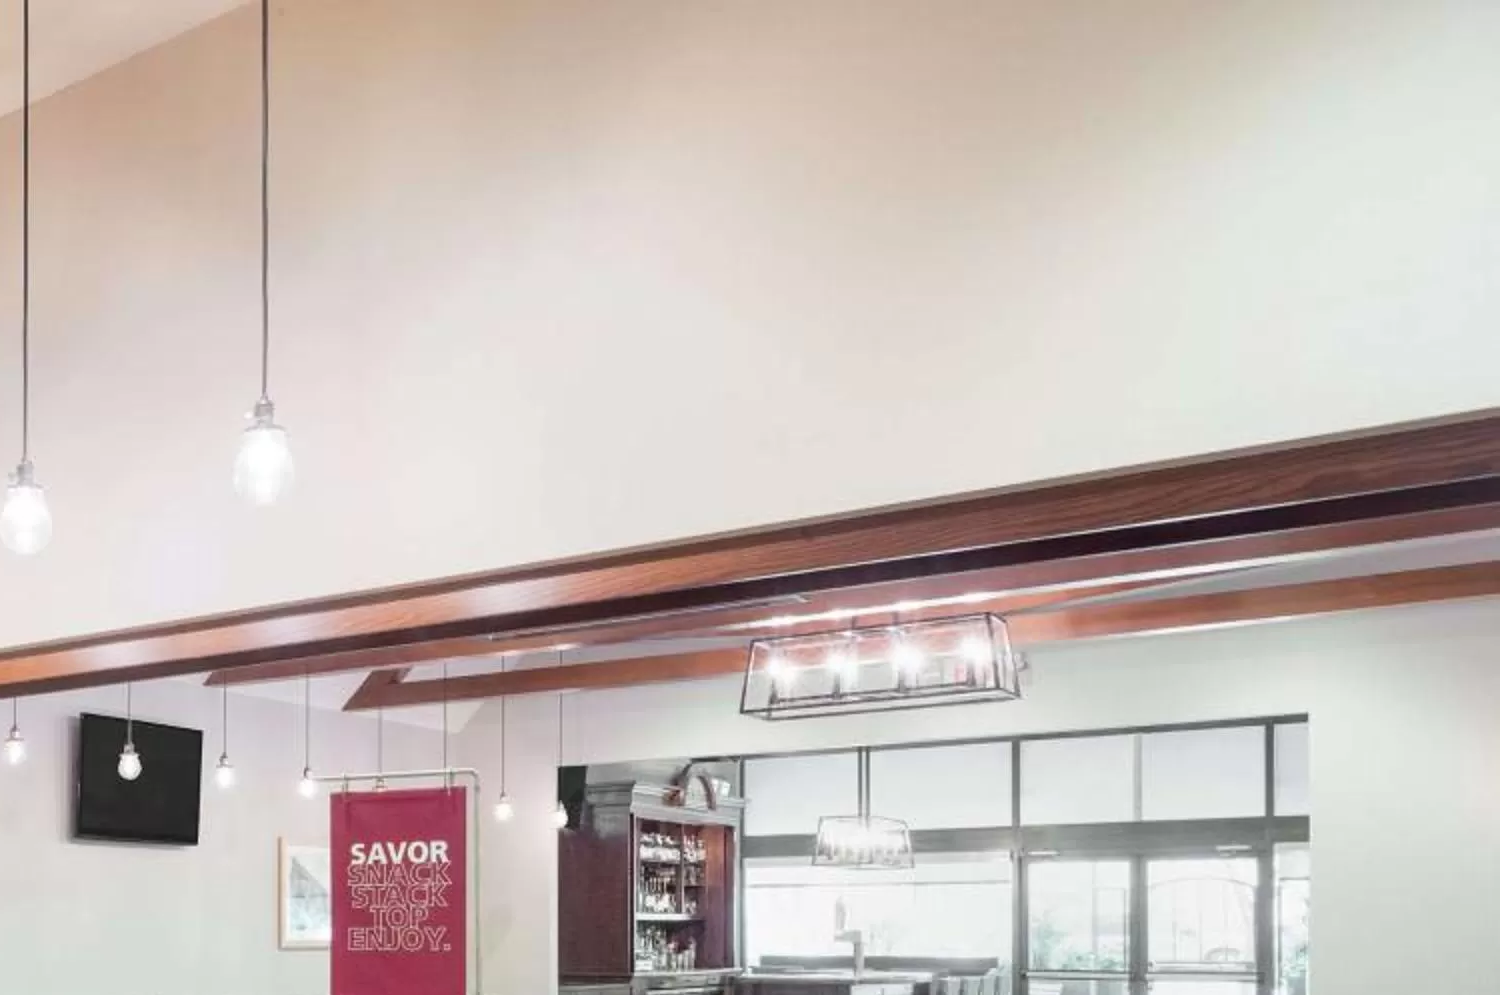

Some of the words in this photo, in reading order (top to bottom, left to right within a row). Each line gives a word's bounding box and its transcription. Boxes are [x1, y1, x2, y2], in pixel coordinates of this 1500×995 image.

[351, 840, 449, 864] SAVOR
[348, 860, 452, 886] SNACK
[351, 883, 449, 909] STACK
[370, 905, 429, 929] TOP
[348, 927, 452, 951] ENJOY.
